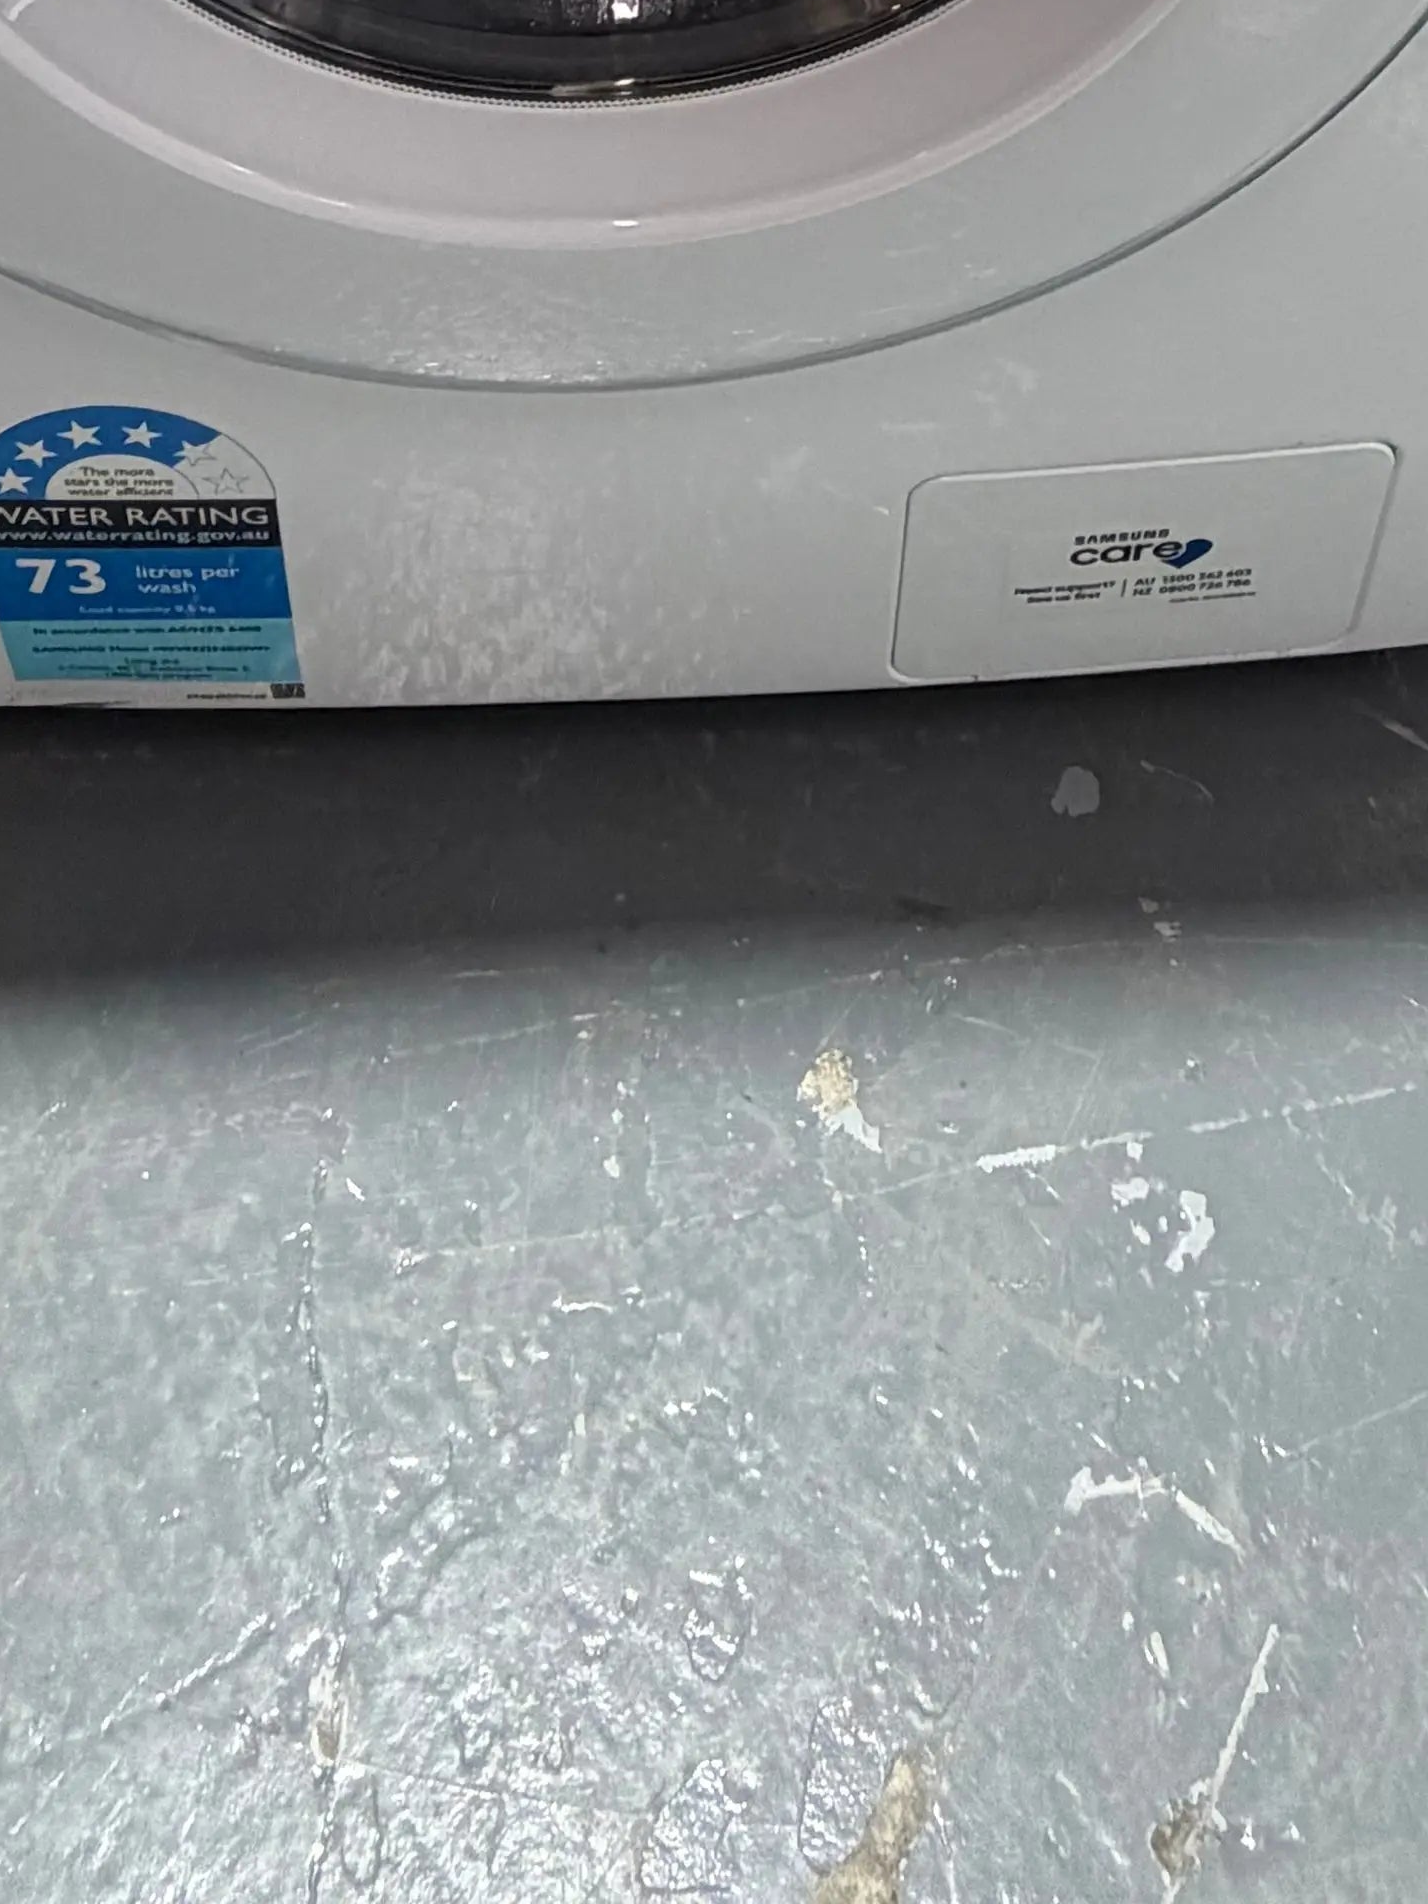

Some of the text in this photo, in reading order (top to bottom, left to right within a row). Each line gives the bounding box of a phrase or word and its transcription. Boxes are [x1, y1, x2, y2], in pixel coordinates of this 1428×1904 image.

[80, 465, 111, 478] The
[126, 506, 270, 527] RATING
[1074, 528, 1171, 546] SAMSUNG
[1069, 540, 1184, 567] care
[15, 557, 241, 594] 73 litres per
[137, 580, 197, 595] wash
